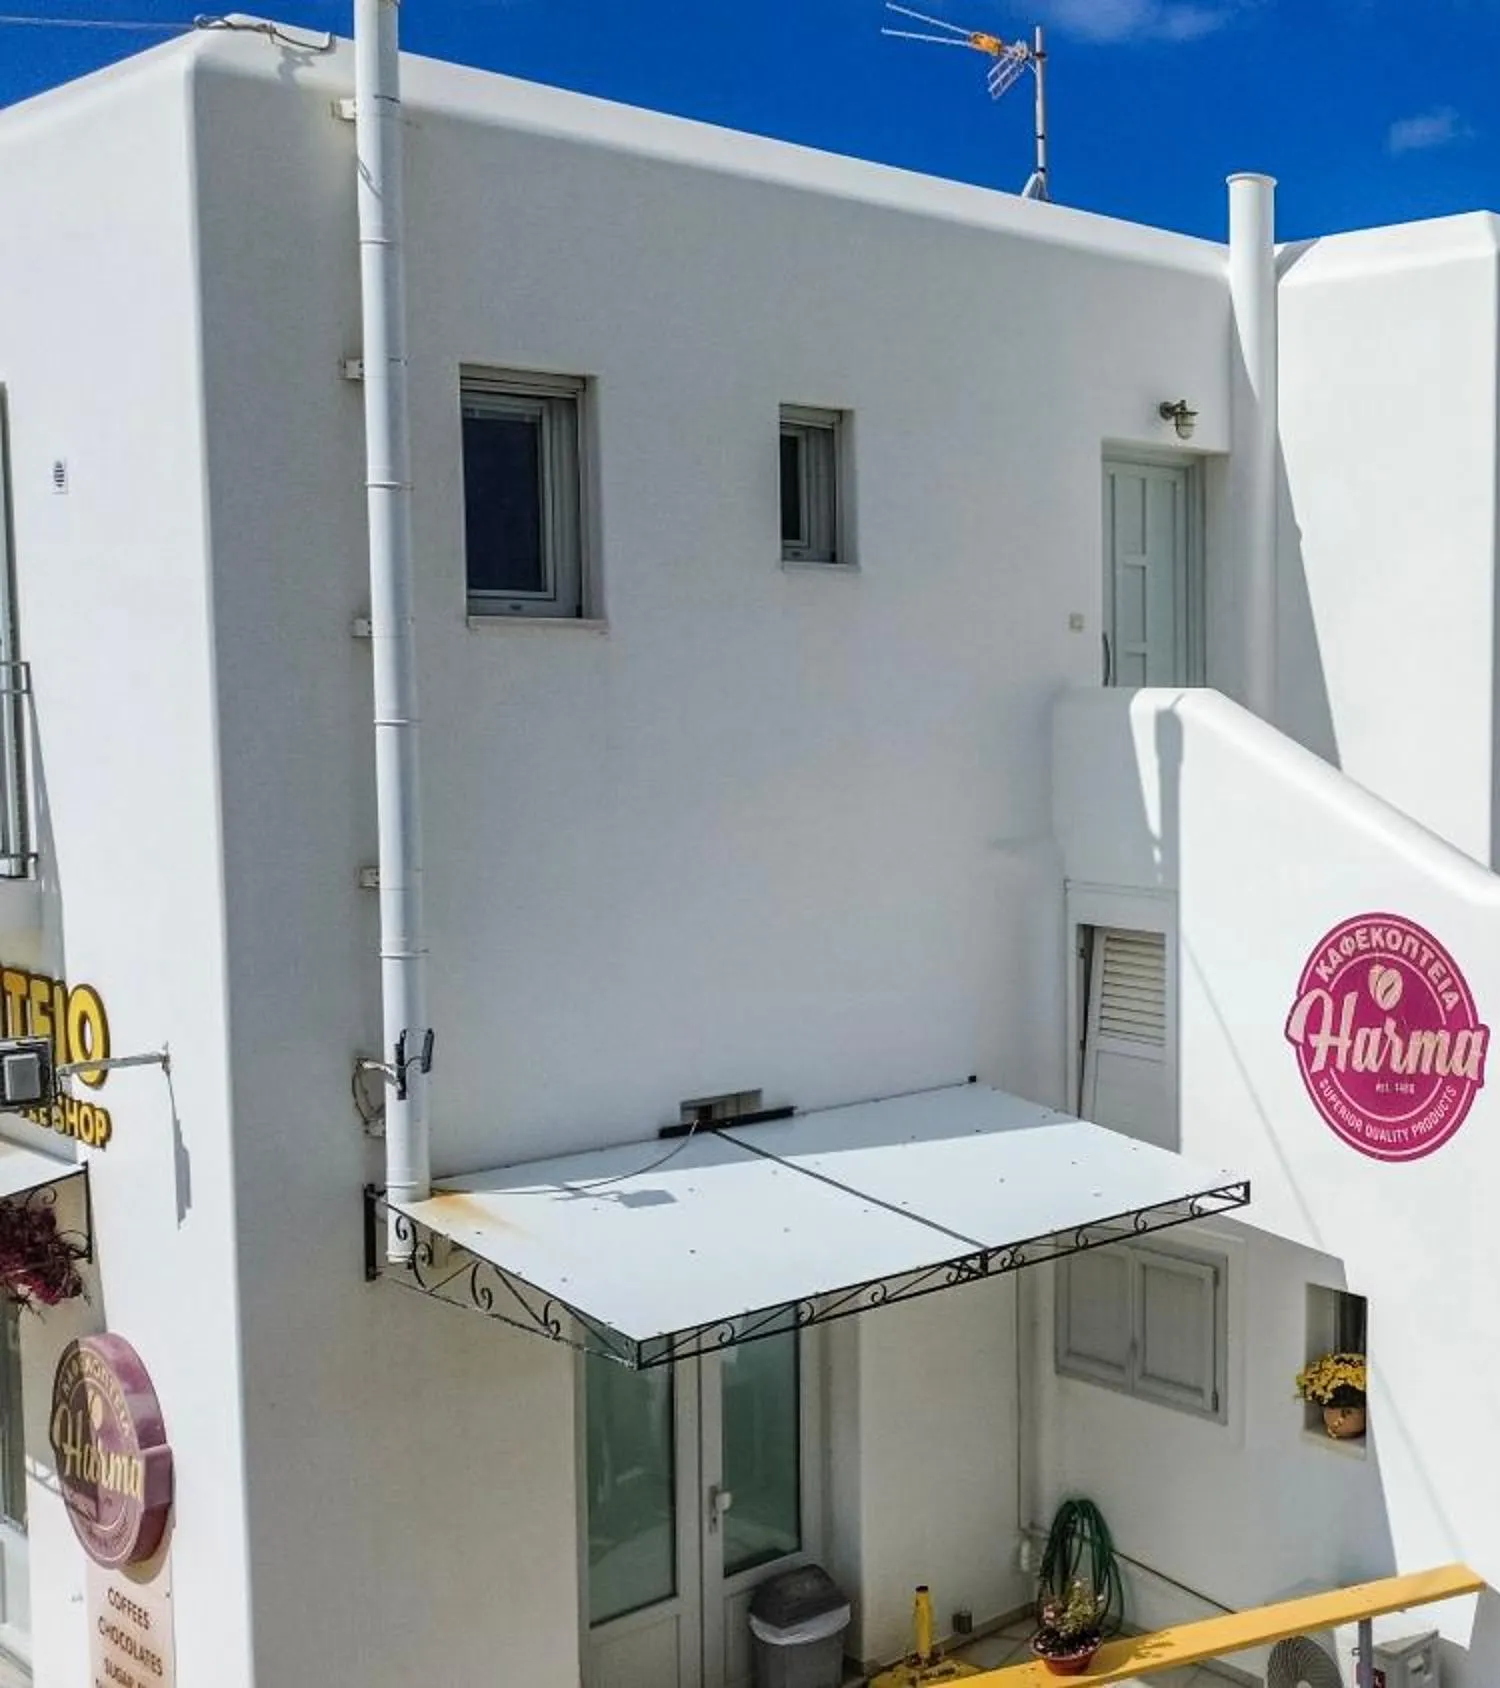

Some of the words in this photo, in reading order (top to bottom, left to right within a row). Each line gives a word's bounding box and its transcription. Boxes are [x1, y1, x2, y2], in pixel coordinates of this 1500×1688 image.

[1315, 927, 1460, 1012] ΚΑΦΕΚΟΠΤΕΙΑ
[1287, 987, 1485, 1081] Harma
[52, 1095, 112, 1149] SHOP
[1319, 1078, 1363, 1133] SUPERIOR
[1365, 1122, 1409, 1143] QUALITY
[1411, 1085, 1457, 1137] PRODUCTS
[52, 1403, 142, 1501] Harma
[107, 1586, 150, 1631] COFFEES
[98, 1615, 163, 1677] CHOCOLATES
